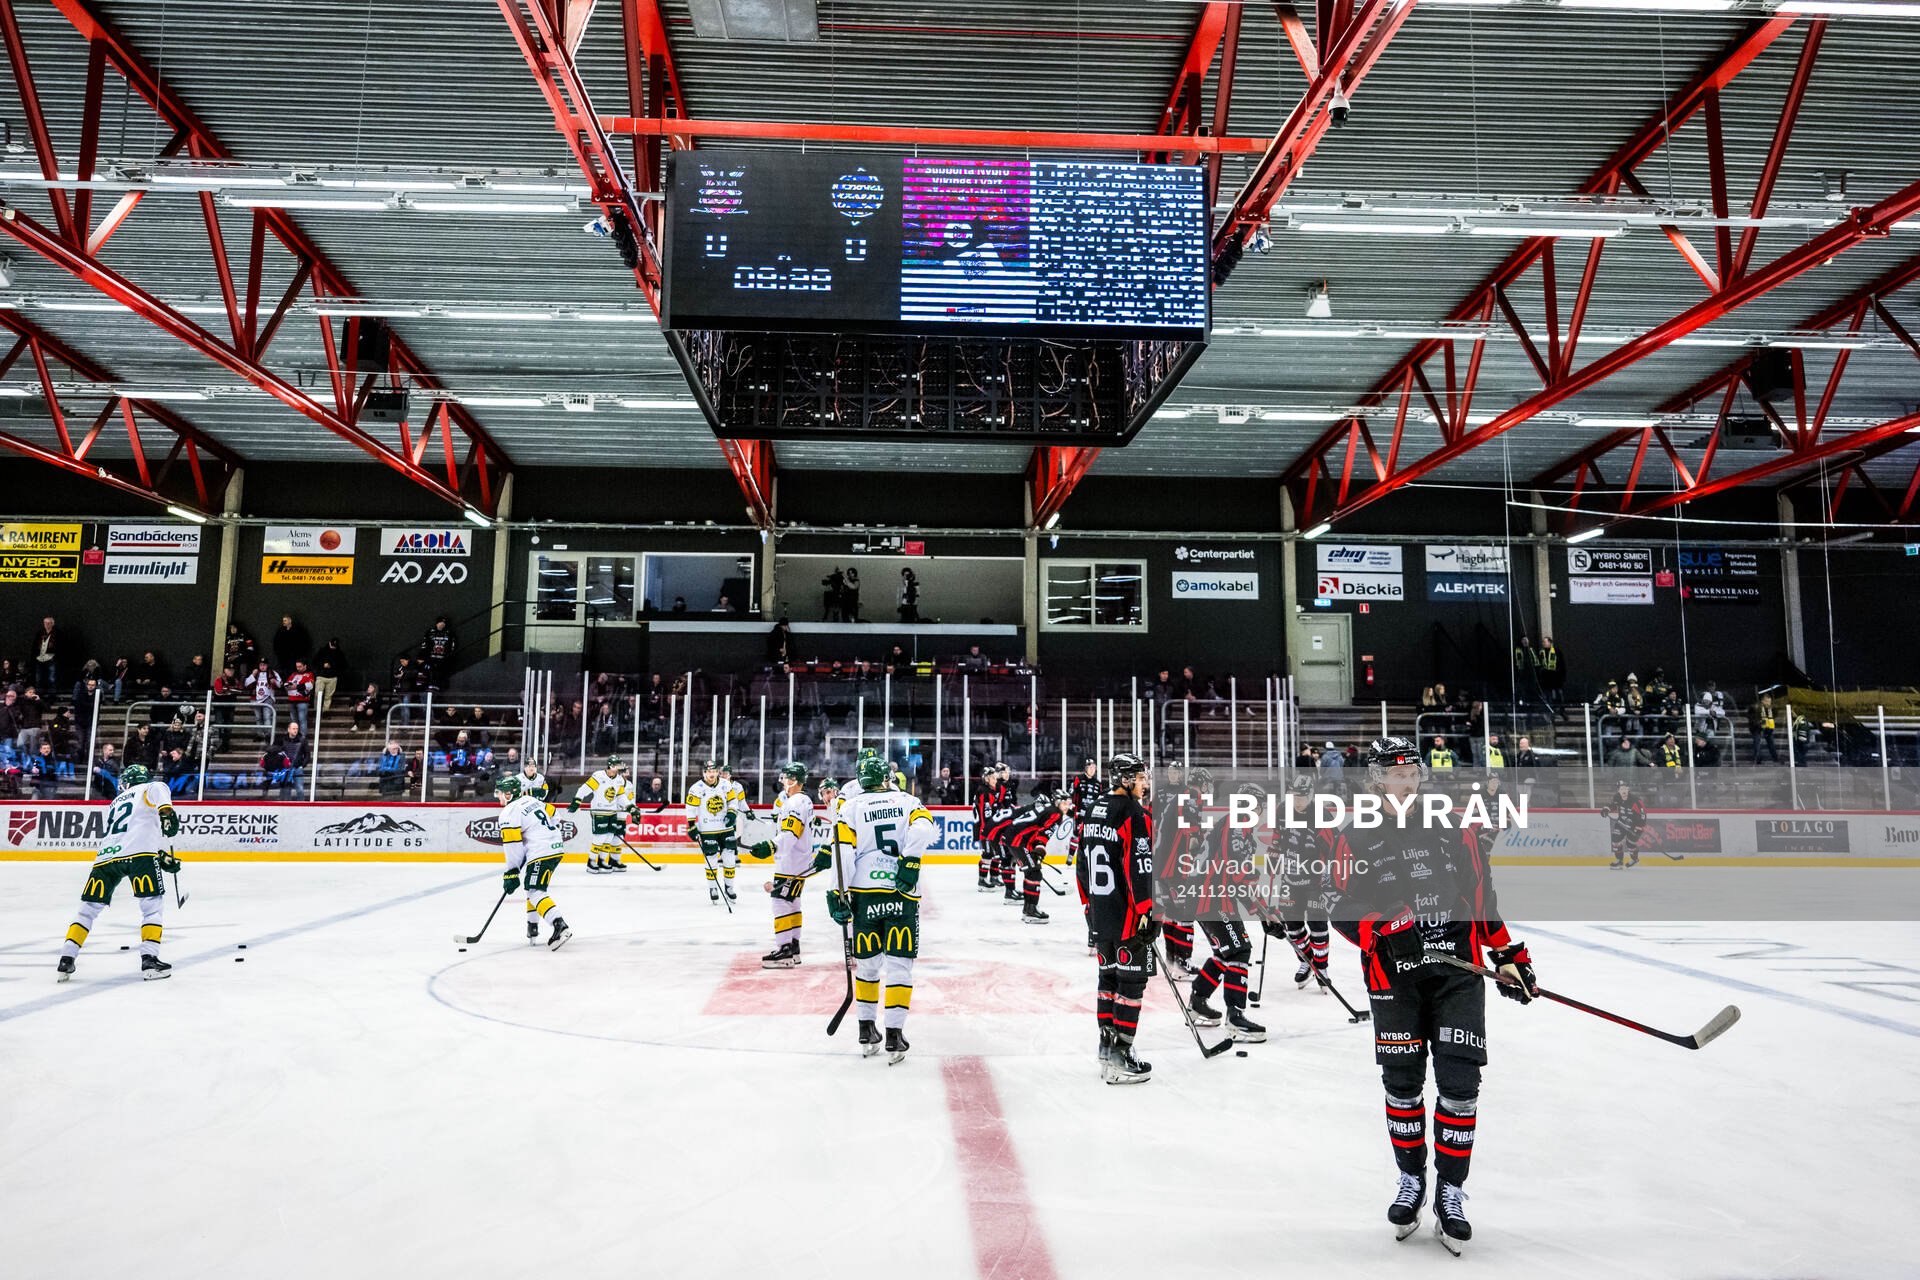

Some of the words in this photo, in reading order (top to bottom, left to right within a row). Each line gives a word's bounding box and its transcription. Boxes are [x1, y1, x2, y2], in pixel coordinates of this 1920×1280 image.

[9, 530, 78, 543] RAMIRENT
[109, 530, 199, 542] Sandbäckens
[396, 531, 464, 549] AGONA
[1189, 549, 1255, 560] Centerpartiet
[1592, 552, 1621, 560] NYBRO
[2, 557, 61, 567] NYBRO
[0, 568, 18, 578] räv
[19, 569, 28, 578] &
[30, 569, 74, 579] Schakt
[1190, 580, 1254, 592] amokabel
[1342, 582, 1402, 596] Däckia
[1434, 583, 1505, 594] ALEMTEK
[1693, 587, 1760, 595] KVARNSTRANDS
[178, 814, 279, 824] UTOTEKNIK
[864, 807, 904, 823] LINDGREN
[38, 811, 104, 839] NBA
[626, 823, 689, 837] CIRCLE
[1770, 820, 1834, 833] TOLAGO
[874, 823, 900, 858] 5
[1884, 826, 1920, 844] Baro
[314, 837, 394, 847] LATITUDE
[1402, 847, 1430, 860] Liljas
[1084, 844, 1116, 896] 16
[1137, 858, 1153, 874] 16
[1412, 862, 1427, 871] ICA
[870, 870, 897, 881] coo
[866, 901, 904, 915] AVION
[1414, 893, 1440, 911] fair
[1422, 940, 1456, 950] ander
[1380, 1032, 1411, 1040] NYBRO
[1376, 1043, 1420, 1054] BYGGPLÅT
[1393, 1121, 1421, 1133] NBAB
[1452, 1130, 1475, 1142] NBA
